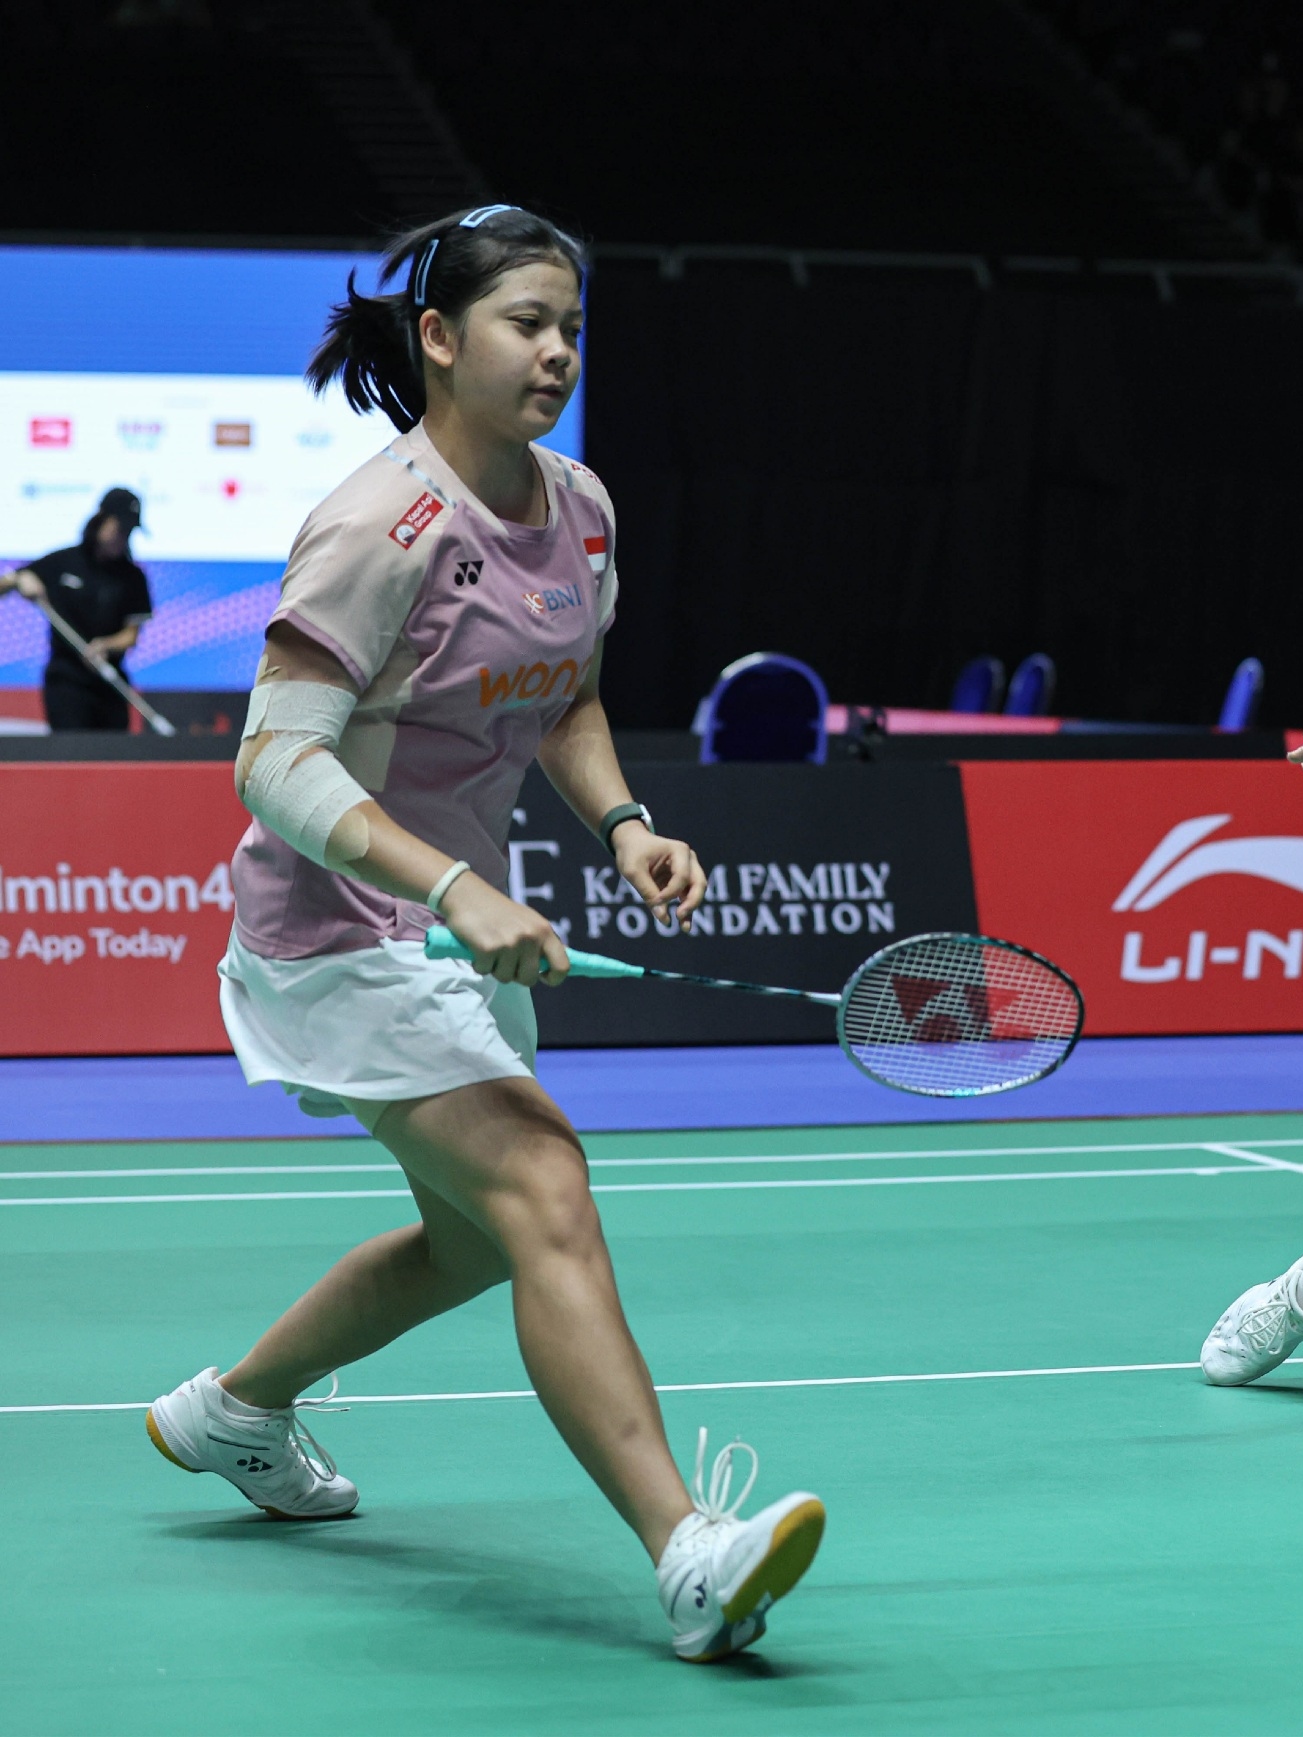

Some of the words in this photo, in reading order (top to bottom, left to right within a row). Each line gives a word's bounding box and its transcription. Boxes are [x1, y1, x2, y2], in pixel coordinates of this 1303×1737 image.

[542, 583, 583, 612] BNI
[479, 656, 593, 708] won
[0, 862, 236, 913] minton4
[736, 861, 891, 902] FAMILY
[584, 902, 896, 939] FOUNDATION
[16, 928, 85, 965] App
[88, 926, 188, 965] Today
